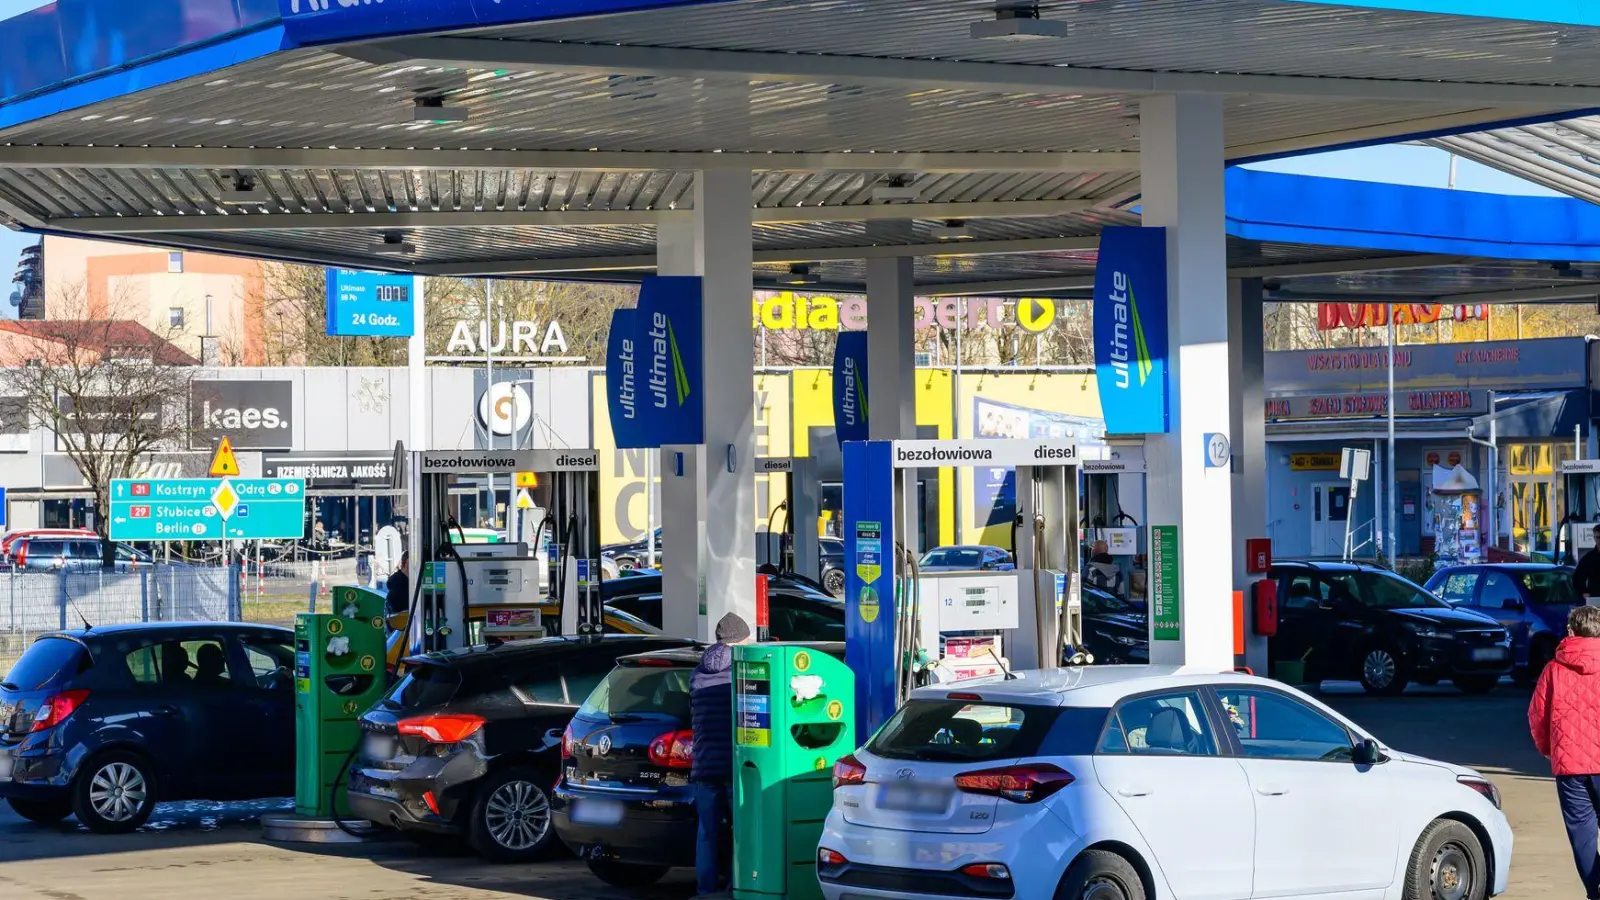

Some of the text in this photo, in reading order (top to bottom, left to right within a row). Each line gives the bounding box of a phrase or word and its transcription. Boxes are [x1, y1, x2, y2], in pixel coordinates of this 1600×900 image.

[352, 313, 400, 325] 24 Godz.
[446, 320, 569, 354] AURA
[1108, 270, 1129, 389] ultimate
[649, 311, 667, 409] ultimate
[618, 338, 635, 419] ultimate
[843, 356, 855, 426] ultimate
[203, 400, 288, 429] kaes.
[896, 444, 1076, 462] bezołowiowa diesel
[1212, 441, 1225, 459] 12
[424, 453, 597, 468] bezołowiowa diesel
[764, 459, 791, 469] diesel
[1083, 462, 1126, 471] bezołowiowa
[277, 464, 348, 479] RZEMIEŚLNICZA
[350, 463, 387, 478] JAKOŚĆ
[135, 484, 146, 495] 31
[156, 483, 206, 498] Kostrzyn
[236, 483, 265, 498] Odrą
[269, 483, 280, 494] PL
[134, 506, 147, 517] 29
[156, 505, 201, 518] Słubice
[156, 521, 190, 534] Berlin
[944, 598, 953, 607] 12
[969, 810, 990, 820] i20
